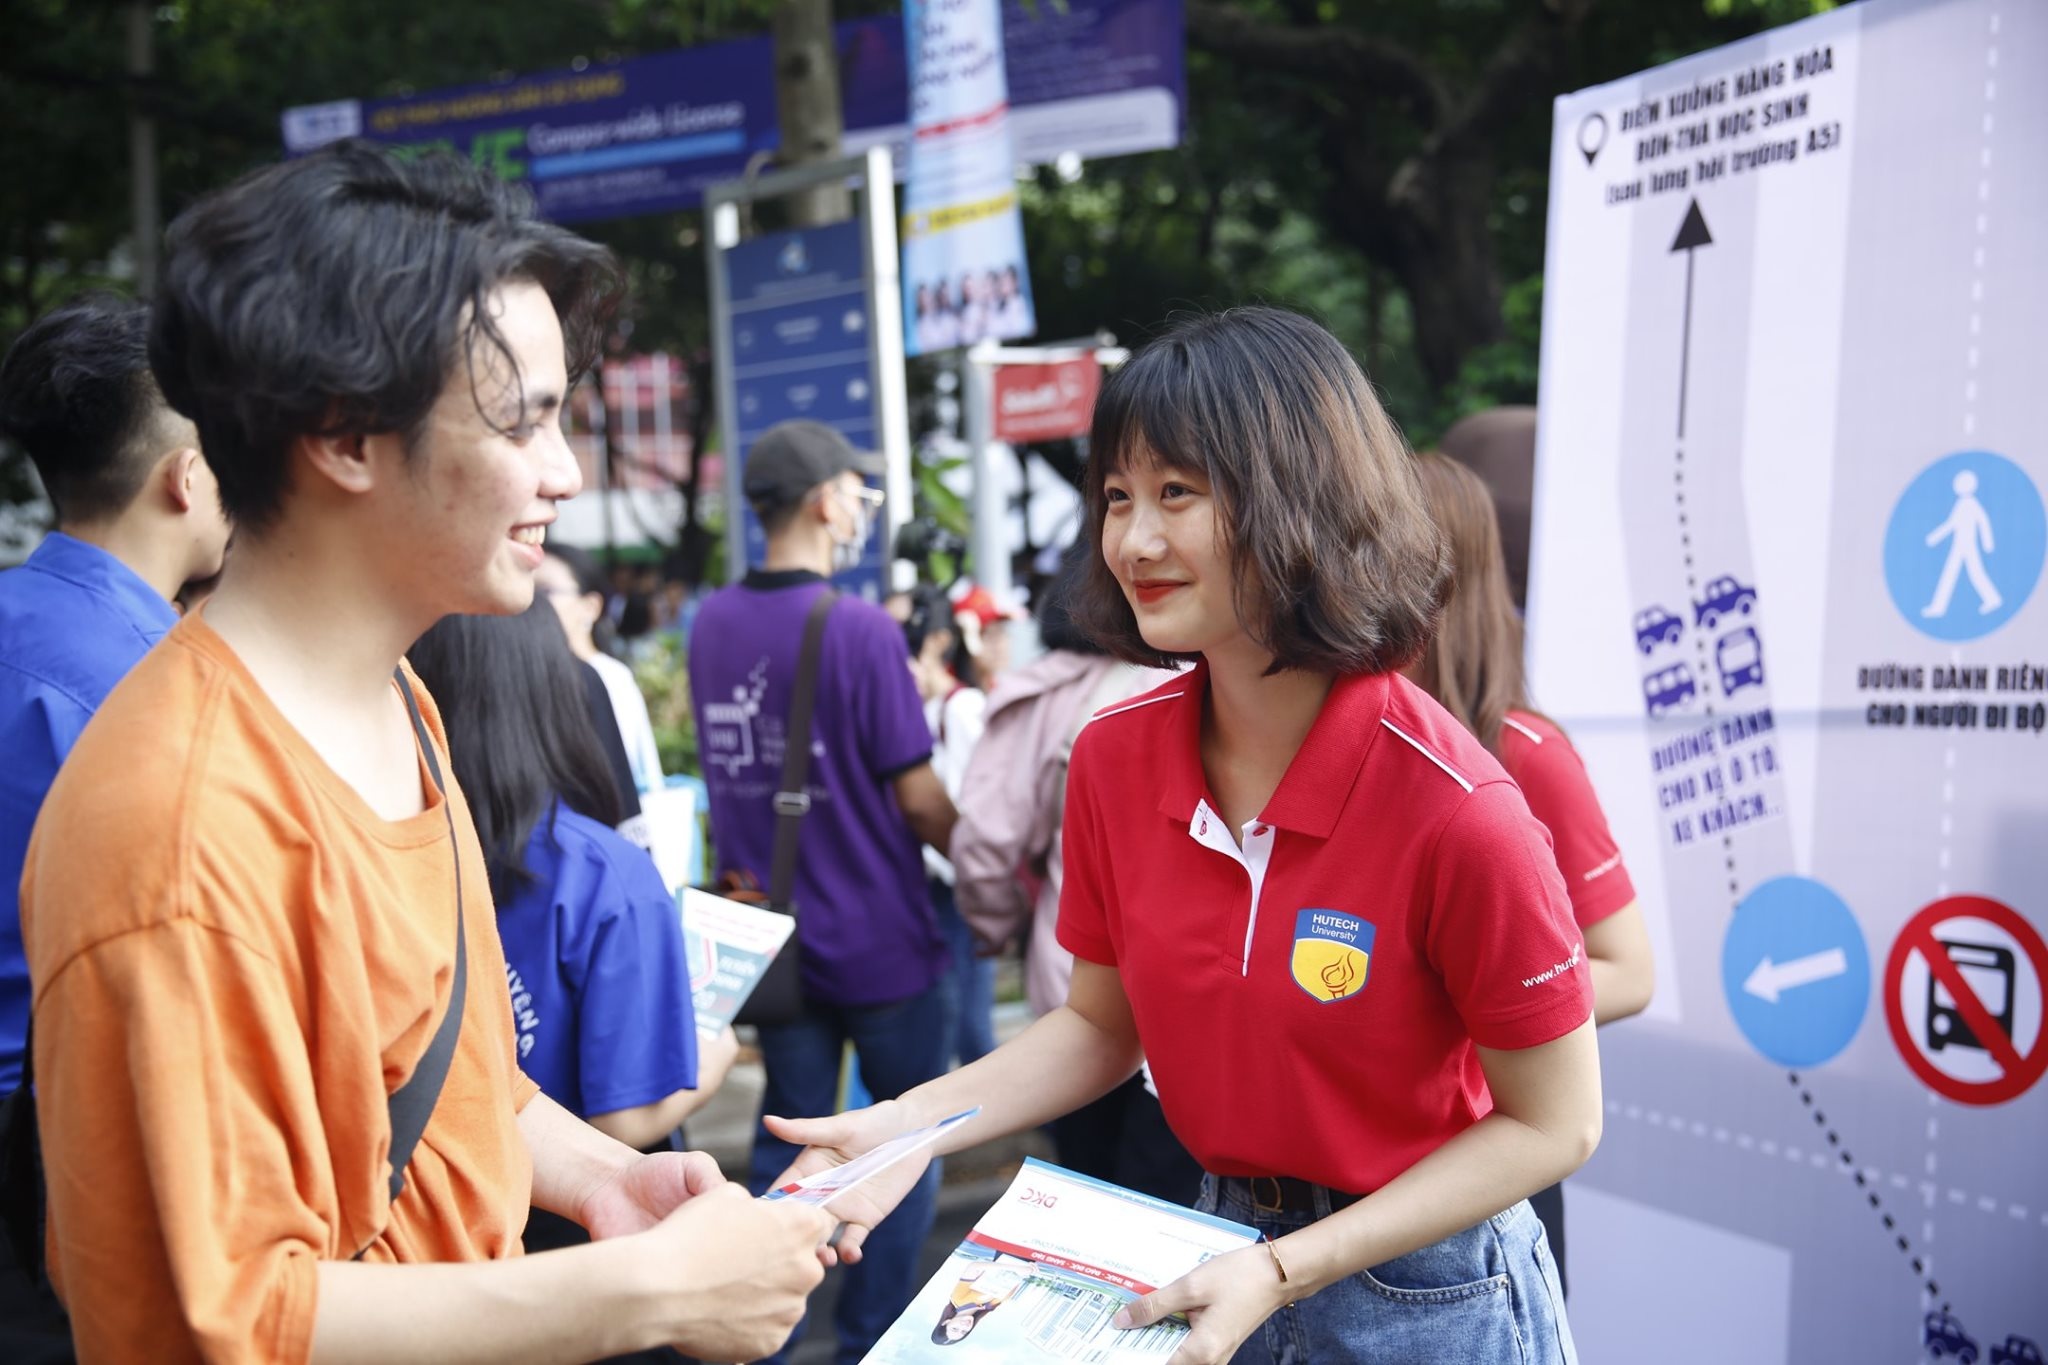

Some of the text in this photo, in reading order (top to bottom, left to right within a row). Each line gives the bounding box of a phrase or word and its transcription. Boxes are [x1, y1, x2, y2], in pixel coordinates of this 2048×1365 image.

[1763, 92, 1809, 126] SINH
[1997, 661, 2048, 691] RIÊN
[1867, 703, 1906, 726] CHO
[2016, 702, 2045, 735] BỘ
[1660, 777, 1696, 808] CHO
[1704, 767, 1724, 792] XE
[1673, 816, 1693, 843] XE
[1311, 924, 1357, 943] University
[1312, 913, 1360, 932] HUTECH
[1020, 1187, 1058, 1208] DKC
